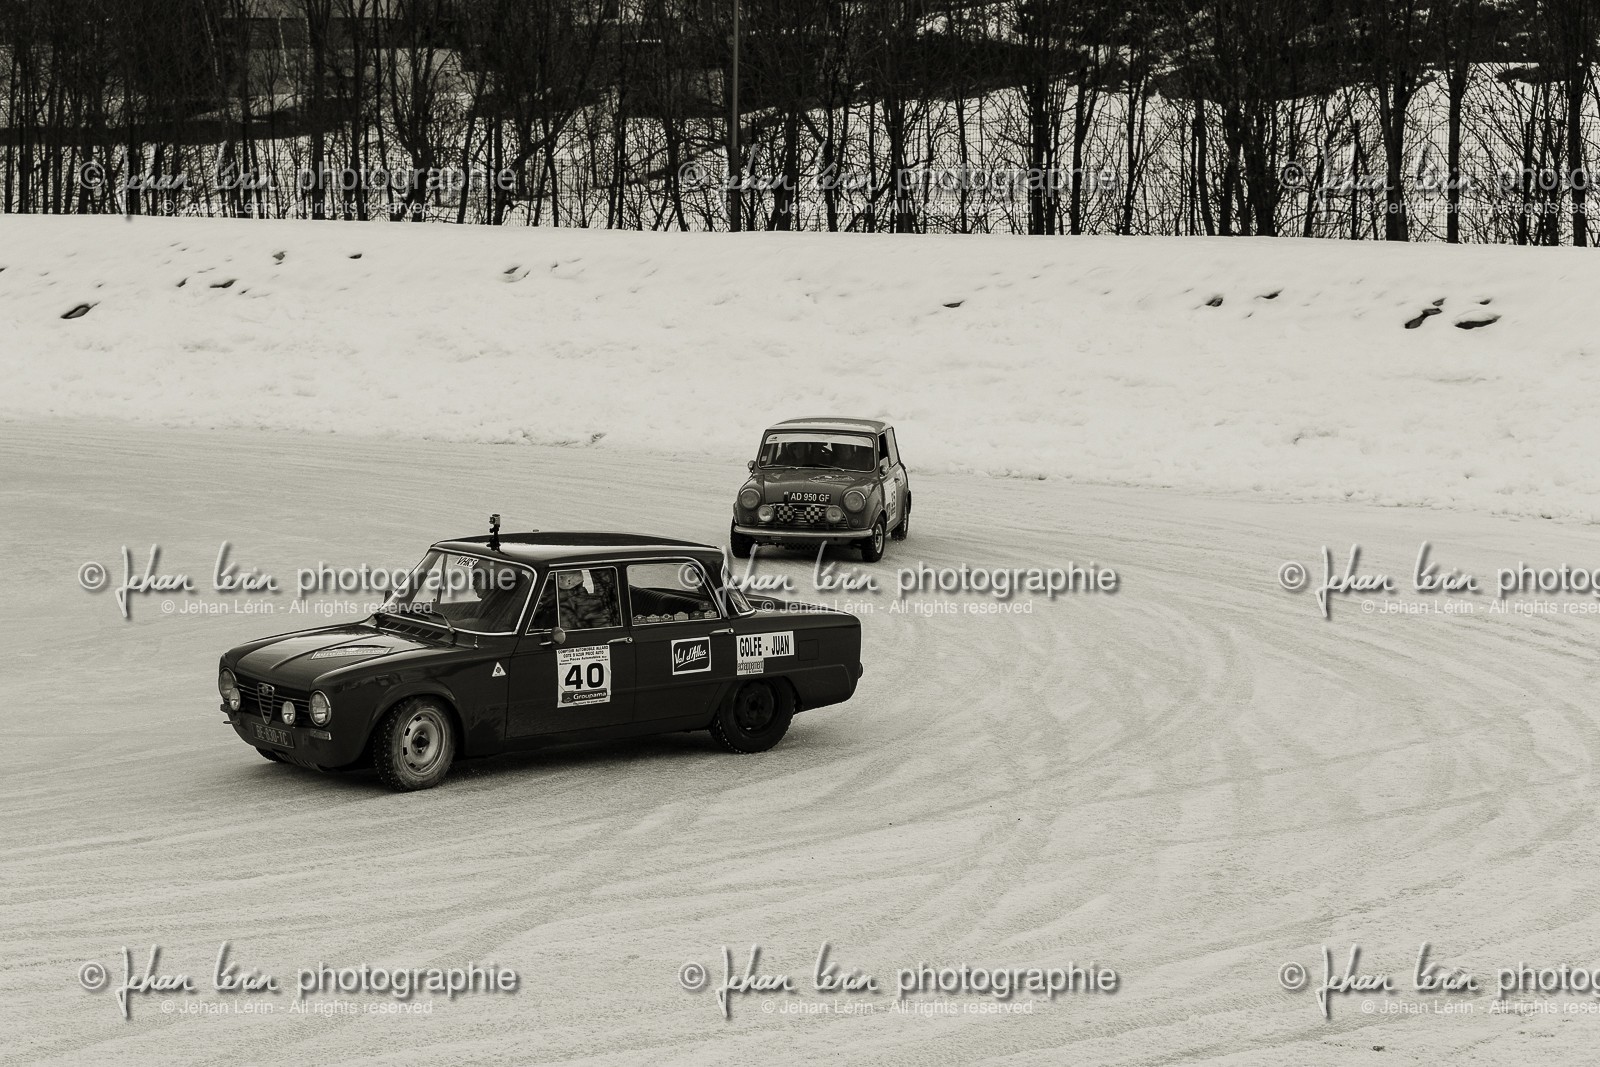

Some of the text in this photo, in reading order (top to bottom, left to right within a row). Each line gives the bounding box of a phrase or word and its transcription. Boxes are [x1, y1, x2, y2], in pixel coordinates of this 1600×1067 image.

[790, 492, 831, 503] AD 950 GF
[740, 636, 763, 658] GOLFE
[771, 635, 791, 656] JUAN
[675, 648, 687, 665] Val
[565, 662, 604, 690] 40
[573, 691, 607, 700] Groupama
